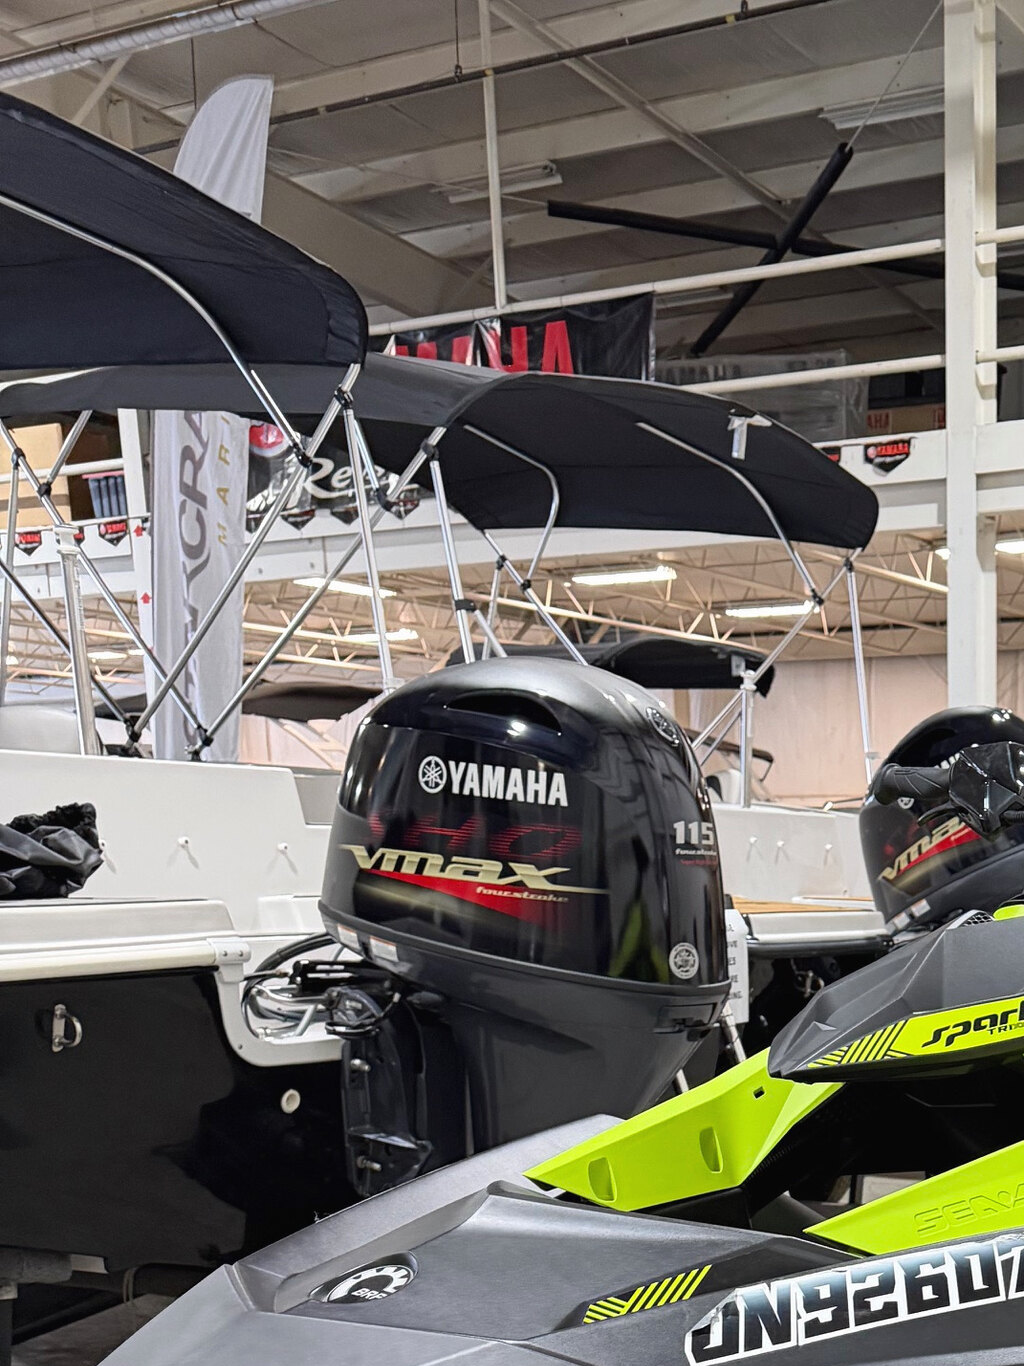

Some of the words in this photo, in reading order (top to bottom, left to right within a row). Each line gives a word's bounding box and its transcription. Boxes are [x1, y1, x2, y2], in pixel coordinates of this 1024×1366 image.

[448, 760, 569, 807] YAMAHA
[673, 820, 715, 845] 115
[351, 1287, 388, 1300] BRP
